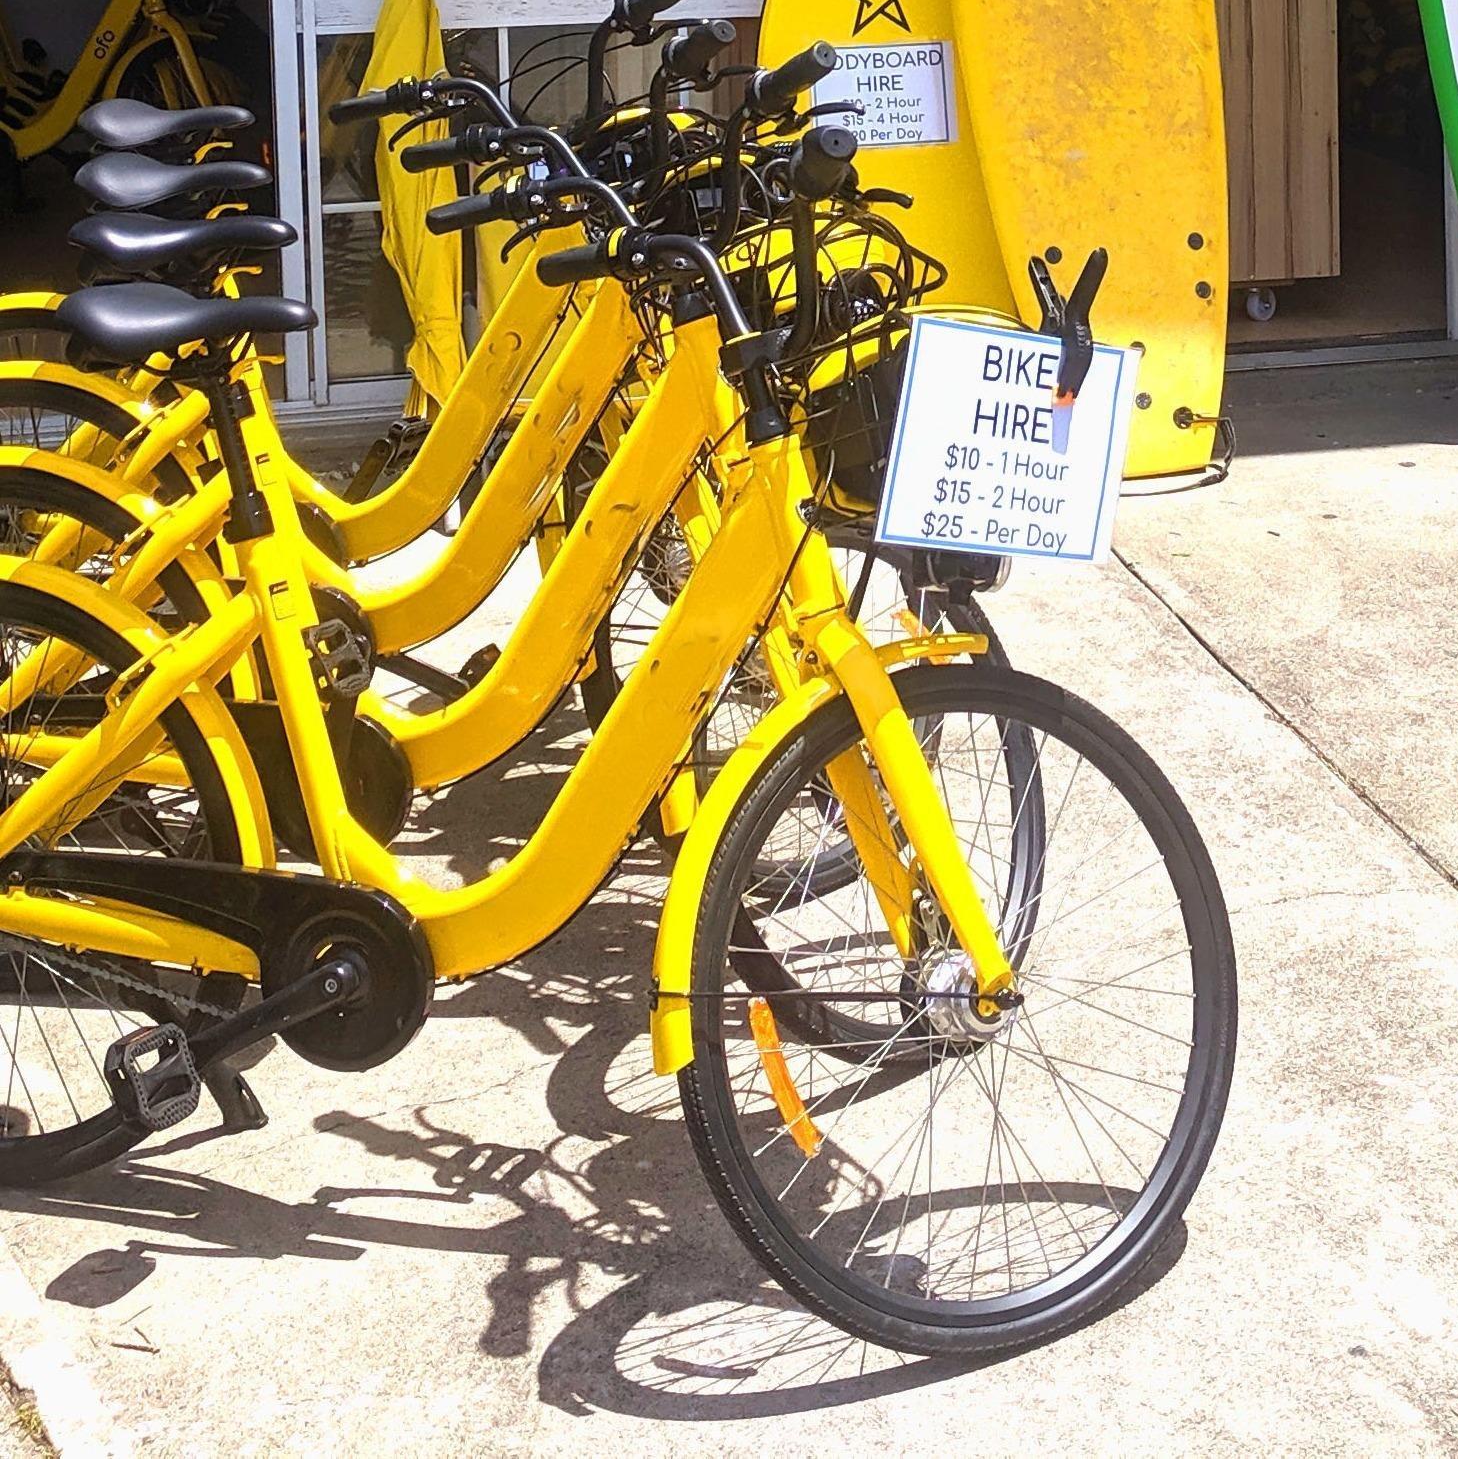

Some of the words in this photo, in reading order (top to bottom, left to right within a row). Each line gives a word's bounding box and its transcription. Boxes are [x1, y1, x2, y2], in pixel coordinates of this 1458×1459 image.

[94, 30, 115, 59] ofo
[834, 50, 941, 70] ODYBOARD
[857, 75, 903, 92] HIRE
[876, 98, 883, 108] 2
[887, 97, 921, 108] Hour
[843, 115, 864, 126] $15
[877, 113, 885, 124] 4
[890, 113, 924, 124] Hour
[871, 129, 892, 140] Per
[897, 128, 922, 140] Day
[983, 345, 1059, 389] BIKE
[973, 399, 1053, 444] HIRE
[945, 443, 980, 471] $10
[1002, 451, 1009, 474] 1
[1014, 453, 1069, 481] Hour
[934, 477, 971, 504] $15
[992, 486, 1004, 509] 2
[1010, 487, 1065, 515] Hour
[921, 511, 963, 538] $25
[986, 519, 1020, 544] Per
[1027, 523, 1067, 556] Day
